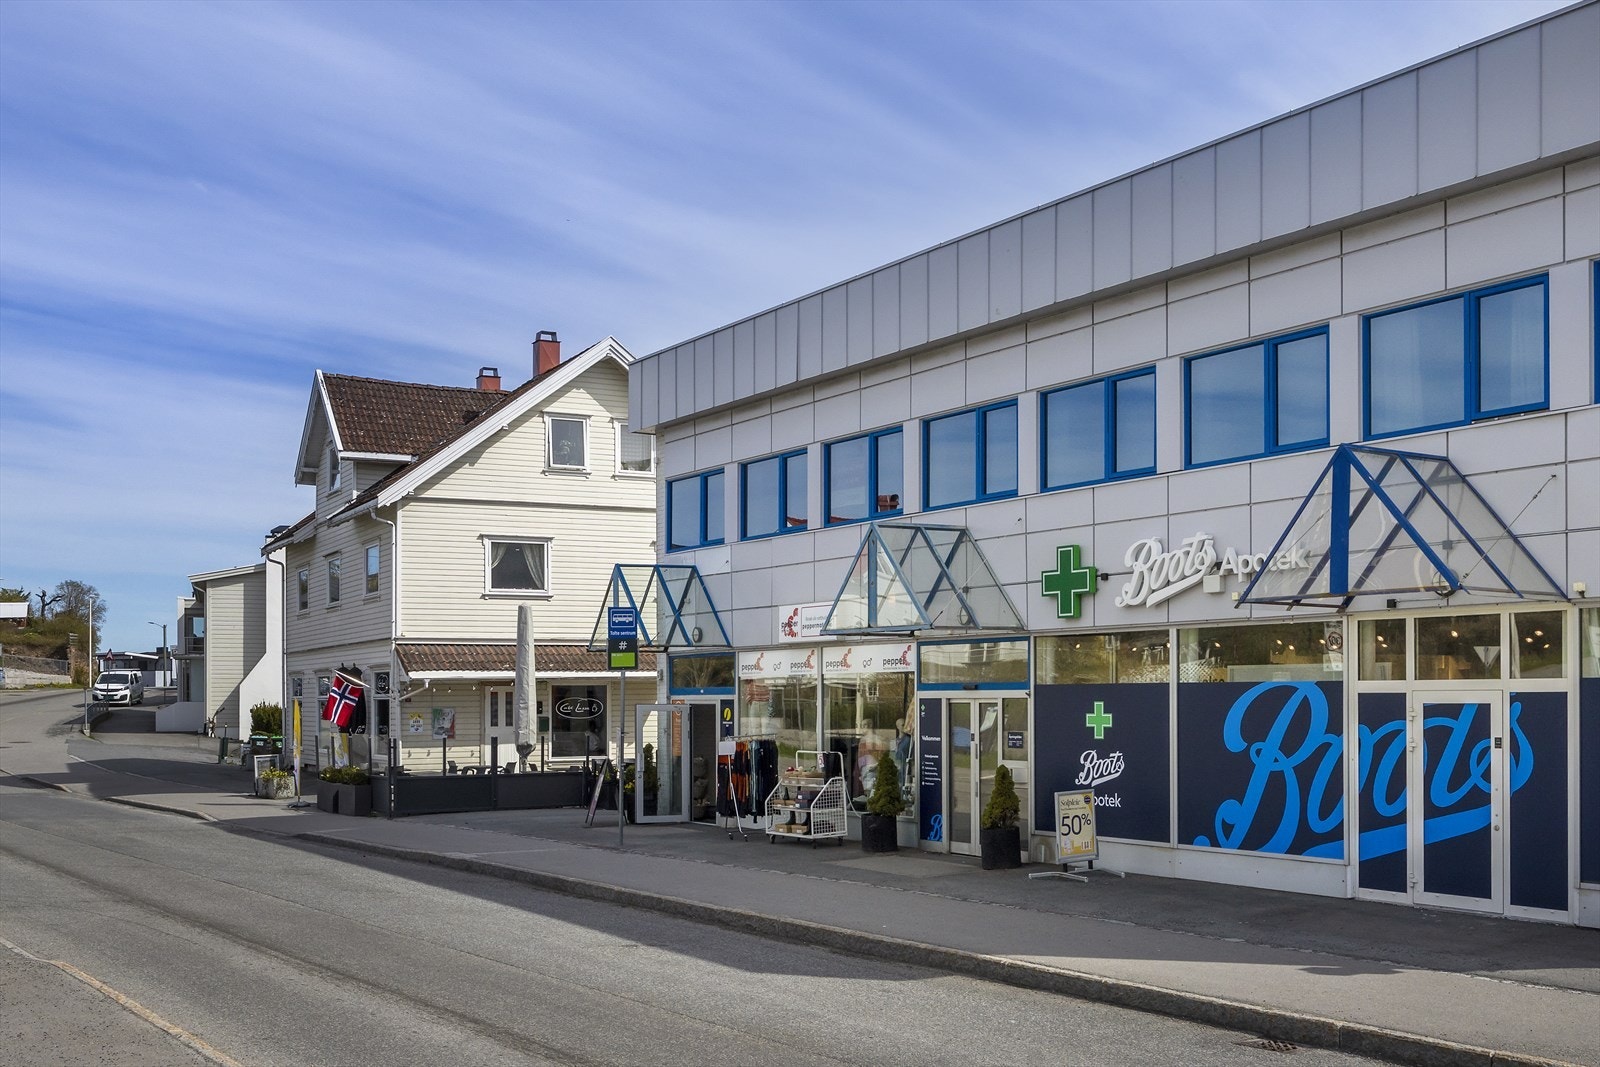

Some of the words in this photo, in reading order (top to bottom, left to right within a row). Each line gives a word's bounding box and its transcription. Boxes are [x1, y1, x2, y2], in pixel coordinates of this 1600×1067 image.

[1115, 531, 1217, 608] Boots
[1219, 540, 1310, 583] Apotek
[1075, 749, 1125, 787] Boots
[1193, 680, 1534, 861] Boots
[1094, 793, 1121, 807] otek
[1060, 813, 1092, 836] 50%
